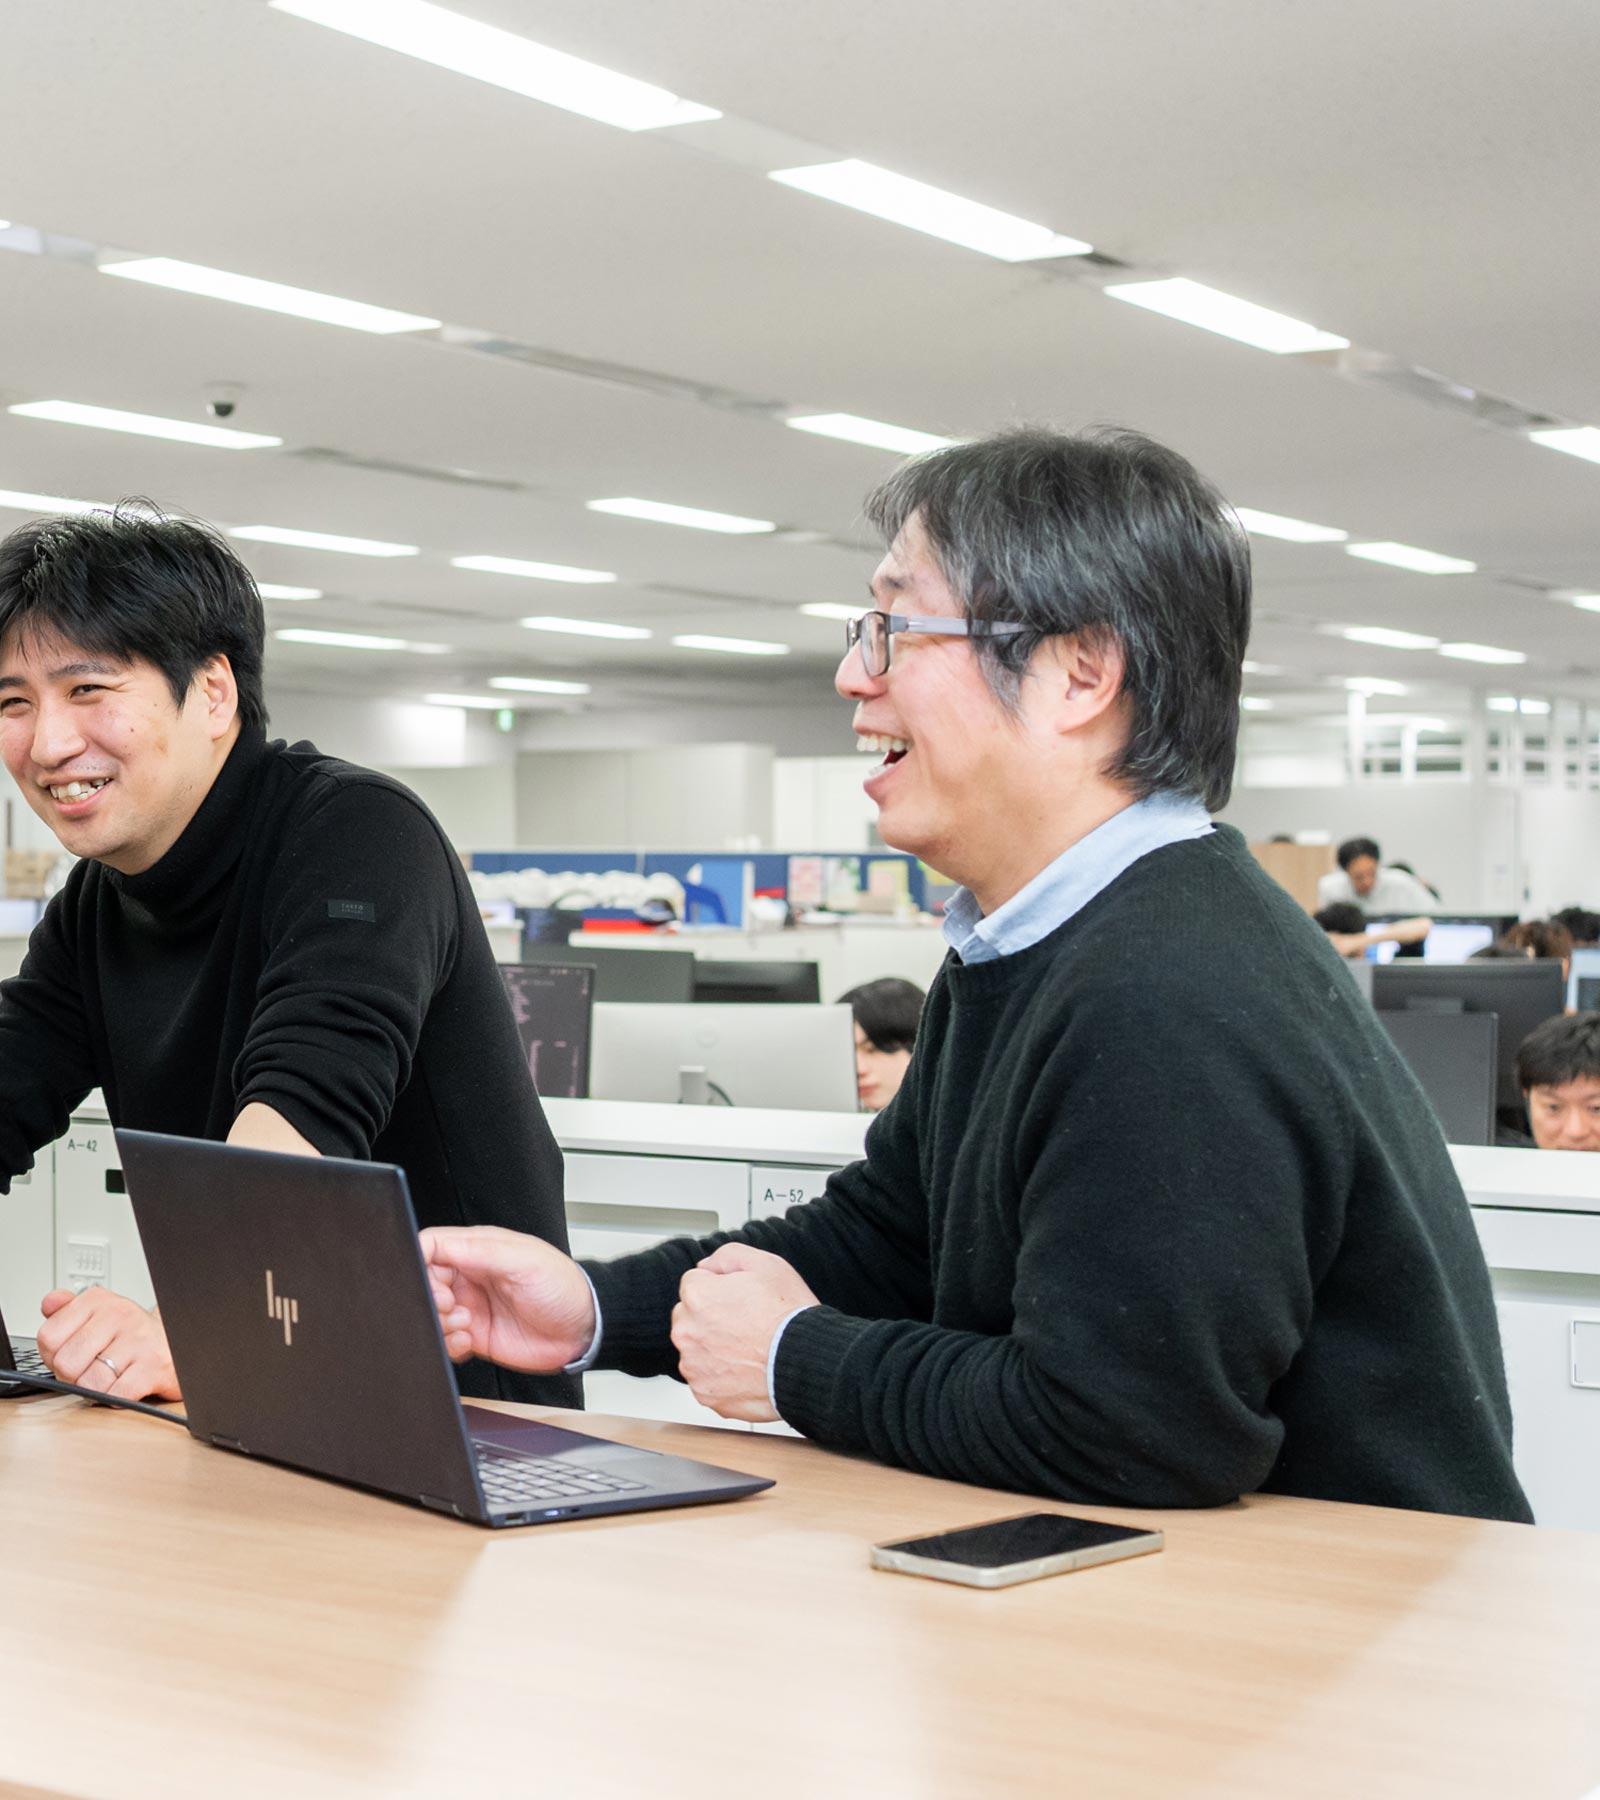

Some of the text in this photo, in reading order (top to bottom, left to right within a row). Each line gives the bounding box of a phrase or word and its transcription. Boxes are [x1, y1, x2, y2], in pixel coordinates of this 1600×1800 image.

[67, 1138, 98, 1152] A-42
[764, 1188, 804, 1204] A-52
[265, 1269, 299, 1346] hp
